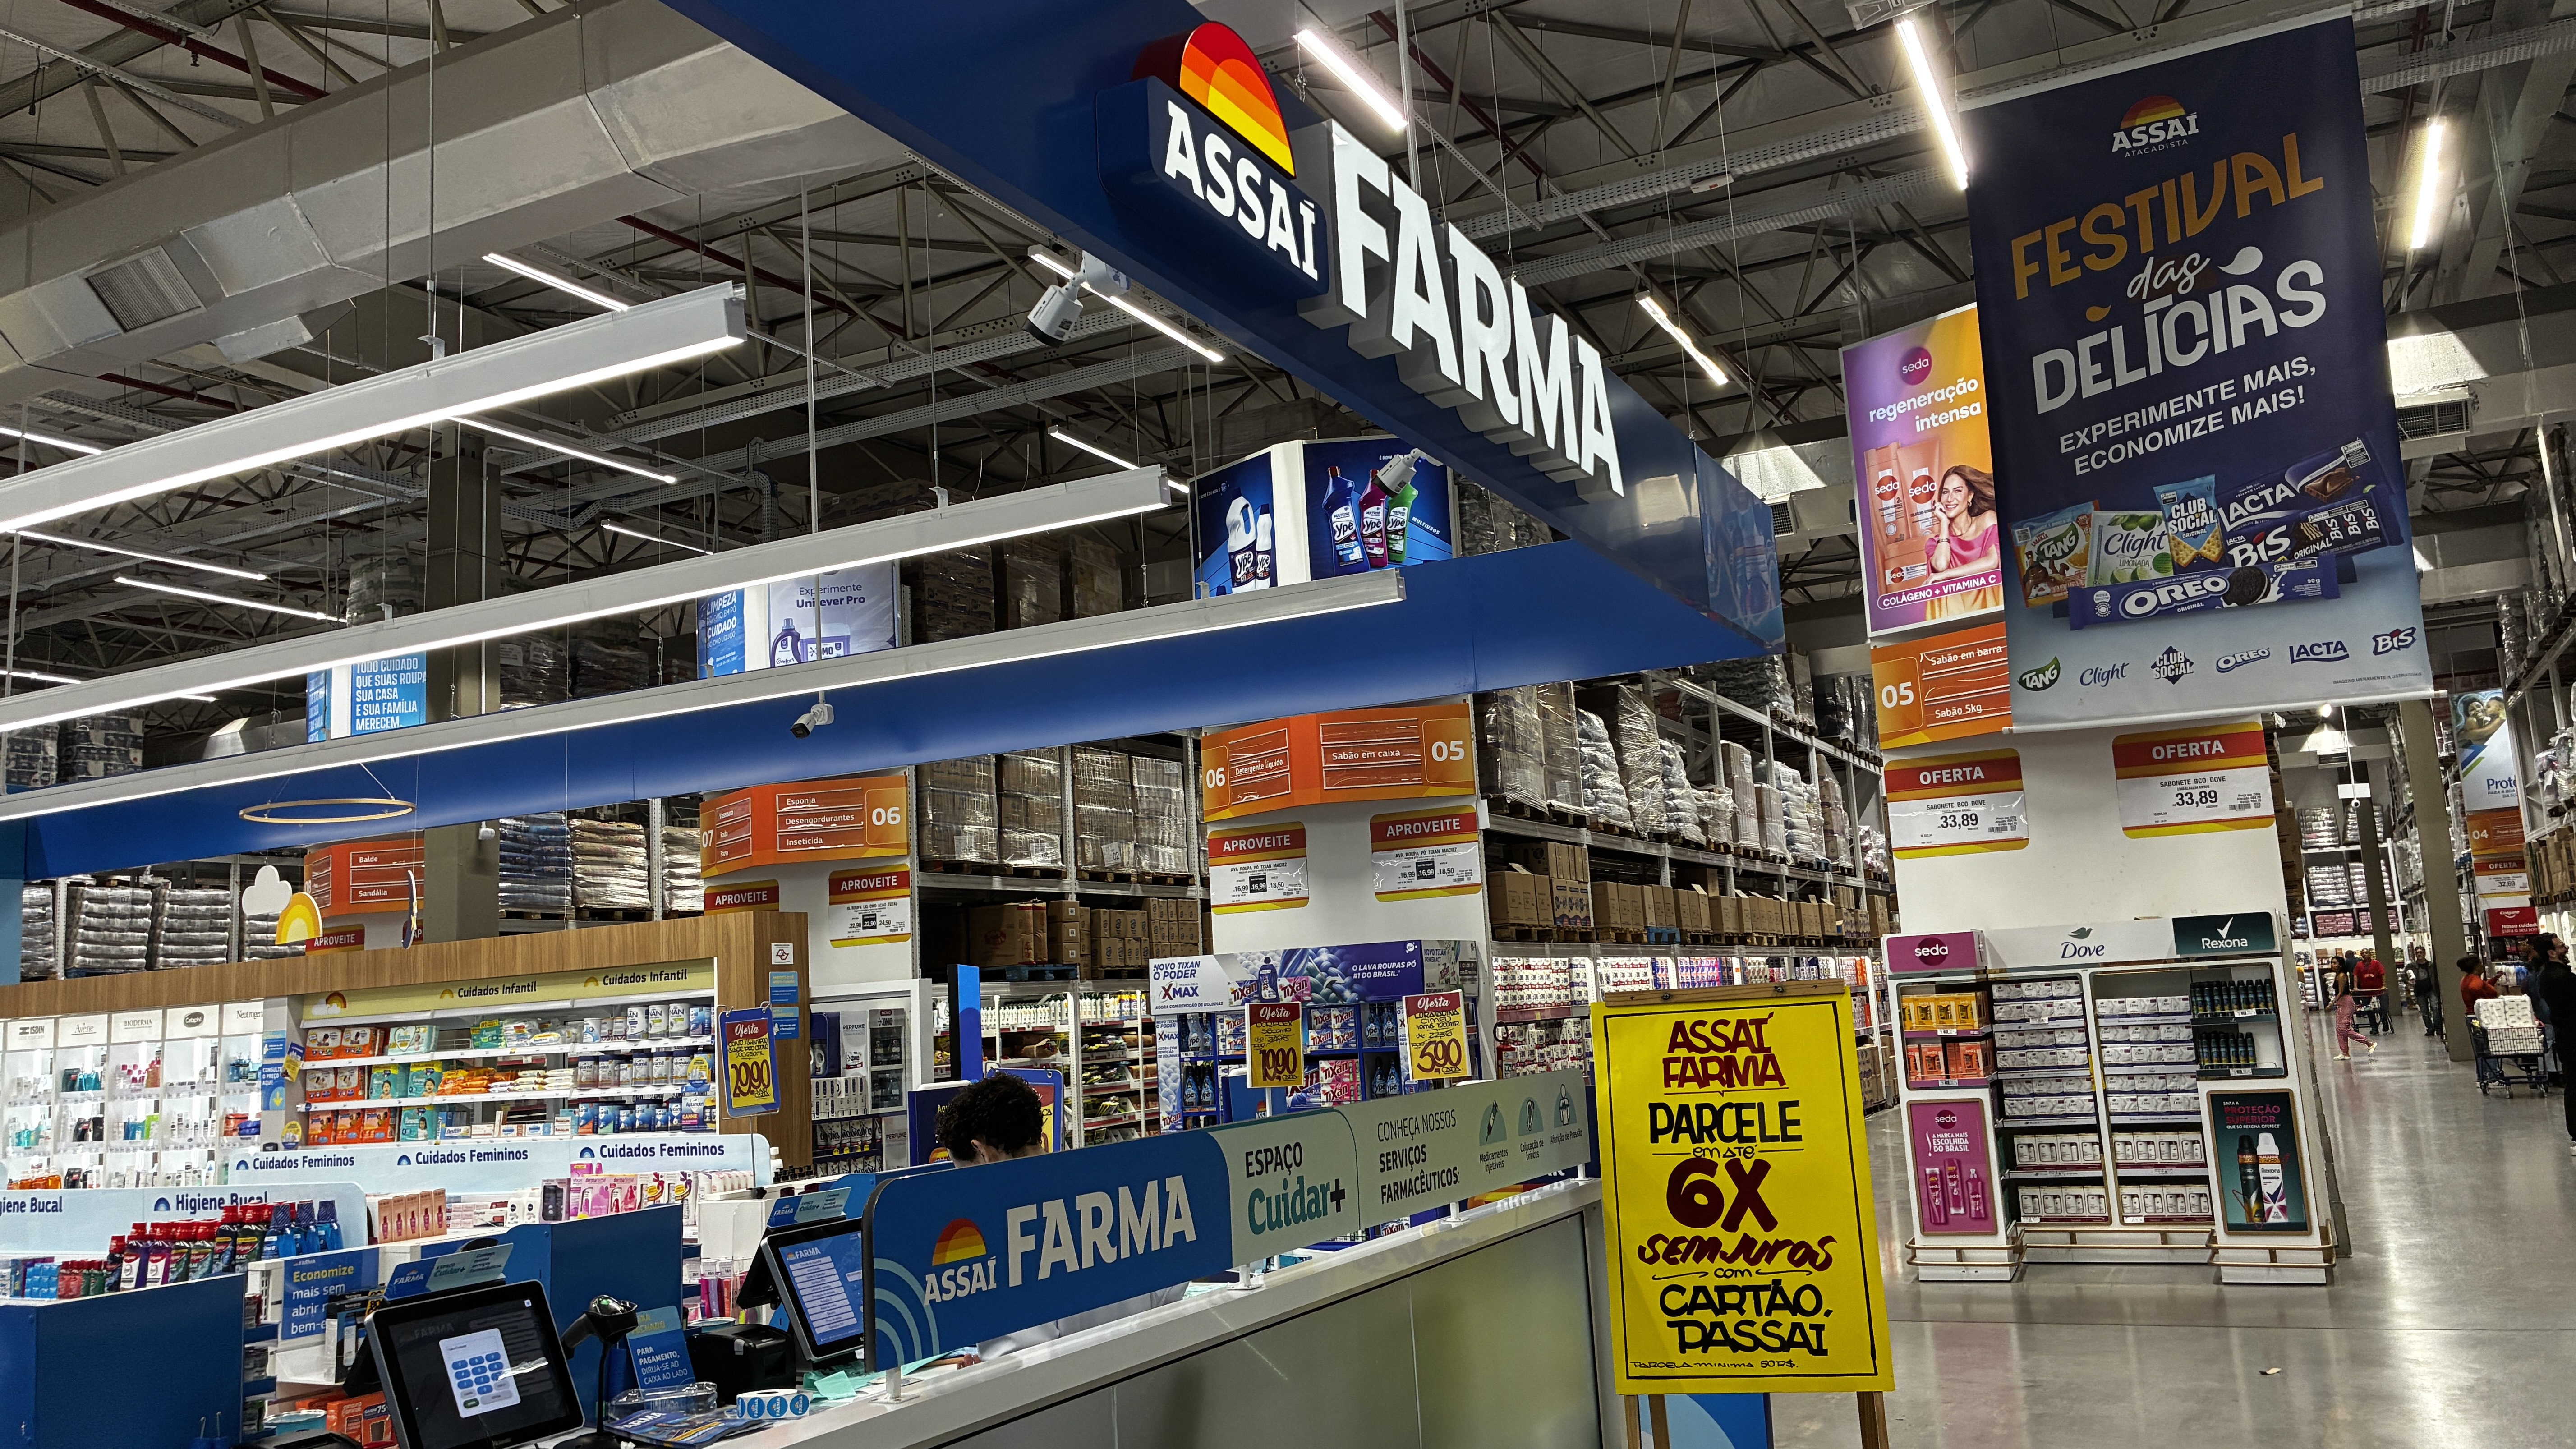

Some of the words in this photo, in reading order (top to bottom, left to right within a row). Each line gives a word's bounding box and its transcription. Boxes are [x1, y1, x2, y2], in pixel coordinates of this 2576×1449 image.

[2112, 113, 2199, 152] ASSAÍ
[2125, 139, 2189, 158] ATACADISTA
[1165, 99, 1318, 281] ASSAÍ
[2011, 132, 2324, 300] FESTIVAL
[2126, 253, 2210, 300] das
[1332, 119, 1624, 497] FARMA
[1902, 358, 1929, 373] seda
[1869, 377, 1979, 423] regeneração
[2059, 379, 2236, 454] EXPERIMENTE
[2243, 356, 2316, 392] MAIS,
[1915, 401, 1981, 432] intensa
[2075, 413, 2224, 476] ECONOMIZE
[2231, 385, 2305, 425] MAIS!
[1875, 480, 1900, 496] seda
[1909, 481, 1937, 497] seda
[2171, 498, 2206, 518] CLUB
[2218, 483, 2295, 532] LACTA
[2182, 529, 2207, 538] ORIGINAL
[2226, 535, 2246, 545] LACTA
[2104, 530, 2167, 558] Clight
[2294, 538, 2332, 560] ORIGINAL
[799, 584, 862, 595] Experimente
[1882, 588, 1933, 607] COLÁGENO
[1942, 578, 1986, 595] VITAMINA
[1988, 575, 1996, 584] C
[2125, 576, 2227, 616] OREO
[707, 591, 736, 615] LIMPEZA
[846, 595, 865, 606] Pro
[708, 616, 737, 639] CUIDADO
[1930, 652, 1959, 667] Sabão
[1961, 650, 1975, 659] em
[1977, 644, 2002, 657] barra
[2155, 651, 2185, 668] CLUB
[2289, 640, 2350, 665] LACTA
[381, 658, 418, 672] CUIDADO
[356, 675, 372, 689] QUE
[374, 673, 397, 686] SUAS
[400, 671, 426, 684] ROUPA
[2022, 665, 2058, 690] TANG
[2079, 662, 2130, 688] Clight
[356, 690, 373, 702] SUA
[375, 689, 398, 701] CASA
[1881, 682, 1914, 708] 05
[356, 705, 361, 716] E
[363, 703, 380, 715] SUA
[382, 698, 417, 713] FAMÍLIA
[1935, 704, 1962, 719] Sabão
[1965, 703, 1983, 716] 5kg
[356, 716, 402, 730] MERECEM.
[1332, 751, 1360, 761] Sabão
[1378, 749, 1400, 758] caixa
[1431, 741, 1464, 762] 05
[2151, 740, 2225, 761] OFERTA
[1235, 760, 1264, 776] Detergente
[1265, 758, 1283, 772] líquido
[1206, 768, 1225, 788] 06
[1919, 767, 1985, 785] OFERTA
[2160, 779, 2191, 787] SABONETE
[787, 797, 816, 806] Esponja
[786, 814, 855, 825] Desengordurantes
[872, 807, 901, 826] 06
[1387, 818, 1460, 837] APROVEITE
[702, 829, 713, 847] 07
[787, 837, 823, 846] Inseticida
[1223, 835, 1290, 852] APROVEITE
[2489, 861, 2517, 869] OFERTA
[841, 876, 897, 891] APROVEITE
[715, 891, 767, 906] APROVEITE
[314, 934, 355, 947] APROVEITE
[2201, 936, 2248, 949] Rexona
[1914, 943, 1949, 958] seda
[2061, 940, 2105, 959] Dove
[1154, 963, 1176, 971] NOVO
[1178, 961, 1200, 969] TIXAN
[1378, 961, 1404, 970] ROUPAS
[603, 973, 646, 986] Cuidados
[650, 969, 687, 982] Infantil
[1153, 972, 1160, 980] O
[1163, 969, 1196, 980] PODER
[458, 984, 499, 998] Cuidados
[502, 981, 537, 994] Infantil
[1417, 997, 1450, 1011] Oferta
[1260, 1007, 1290, 1020] Oferta
[75, 1023, 94, 1034] Avène
[735, 1023, 759, 1037] Oferta
[1668, 1012, 1774, 1054] ASSAÍ
[1662, 1053, 1786, 1088] FARMA
[2224, 1104, 2280, 1114] PROTEÇÃO
[1377, 1114, 1419, 1142] CONHEÇA
[1422, 1109, 1456, 1133] NOSSOS
[1649, 1099, 1802, 1145] PARCELE
[415, 1150, 466, 1164] Cuidados
[469, 1147, 528, 1163] Femininos
[600, 1144, 655, 1158] Cuidados
[660, 1142, 724, 1157] Femininos
[1380, 1144, 1427, 1173] SERVIÇOS
[1479, 1148, 1509, 1164] Medicamentos
[253, 1156, 299, 1170] Cuidados
[302, 1155, 354, 1168] Femininos
[1246, 1141, 1303, 1178] ESPAÇO
[176, 1194, 225, 1214] Higiene
[1666, 1158, 1779, 1233] 6X
[30, 1196, 62, 1213] Bucal
[773, 1207, 794, 1216] FARMA
[1007, 1175, 1197, 1288] FARMA
[794, 1247, 821, 1259] FARMA
[293, 1264, 354, 1283] Economize
[394, 1273, 424, 1285] FARMA
[924, 1256, 997, 1306] ASSAÍ
[293, 1286, 321, 1300] mais
[323, 1282, 345, 1295] sem
[1659, 1278, 1823, 1317] CARTÃO
[292, 1303, 317, 1318] abrir
[637, 1346, 654, 1355] PARA
[639, 1351, 680, 1365] PAGAMENTO,
[671, 1360, 679, 1368] AO
[644, 1374, 662, 1385] CAIXA
[663, 1371, 671, 1380] AO
[672, 1368, 688, 1378] LADO
